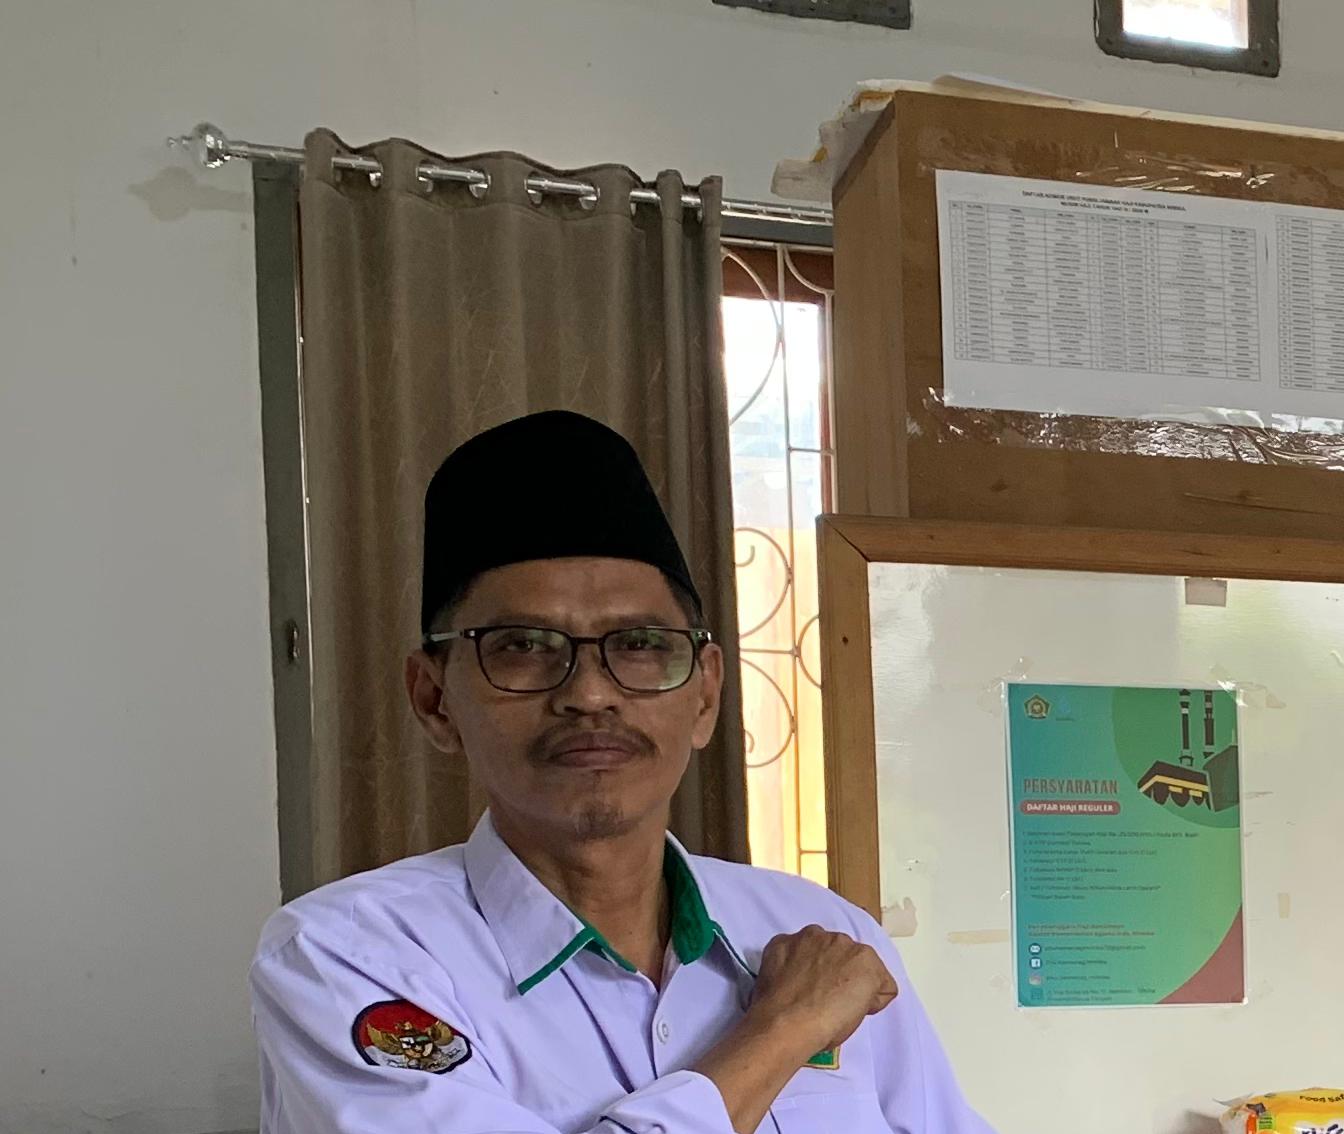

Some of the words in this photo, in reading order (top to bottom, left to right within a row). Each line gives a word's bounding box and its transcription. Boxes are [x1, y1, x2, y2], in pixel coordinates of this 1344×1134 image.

[1023, 778, 1118, 795] PERSYARATAN
[1026, 803, 1058, 812] DAFTAR
[1059, 804, 1077, 814] HAJI
[1078, 804, 1114, 813] REGULER
